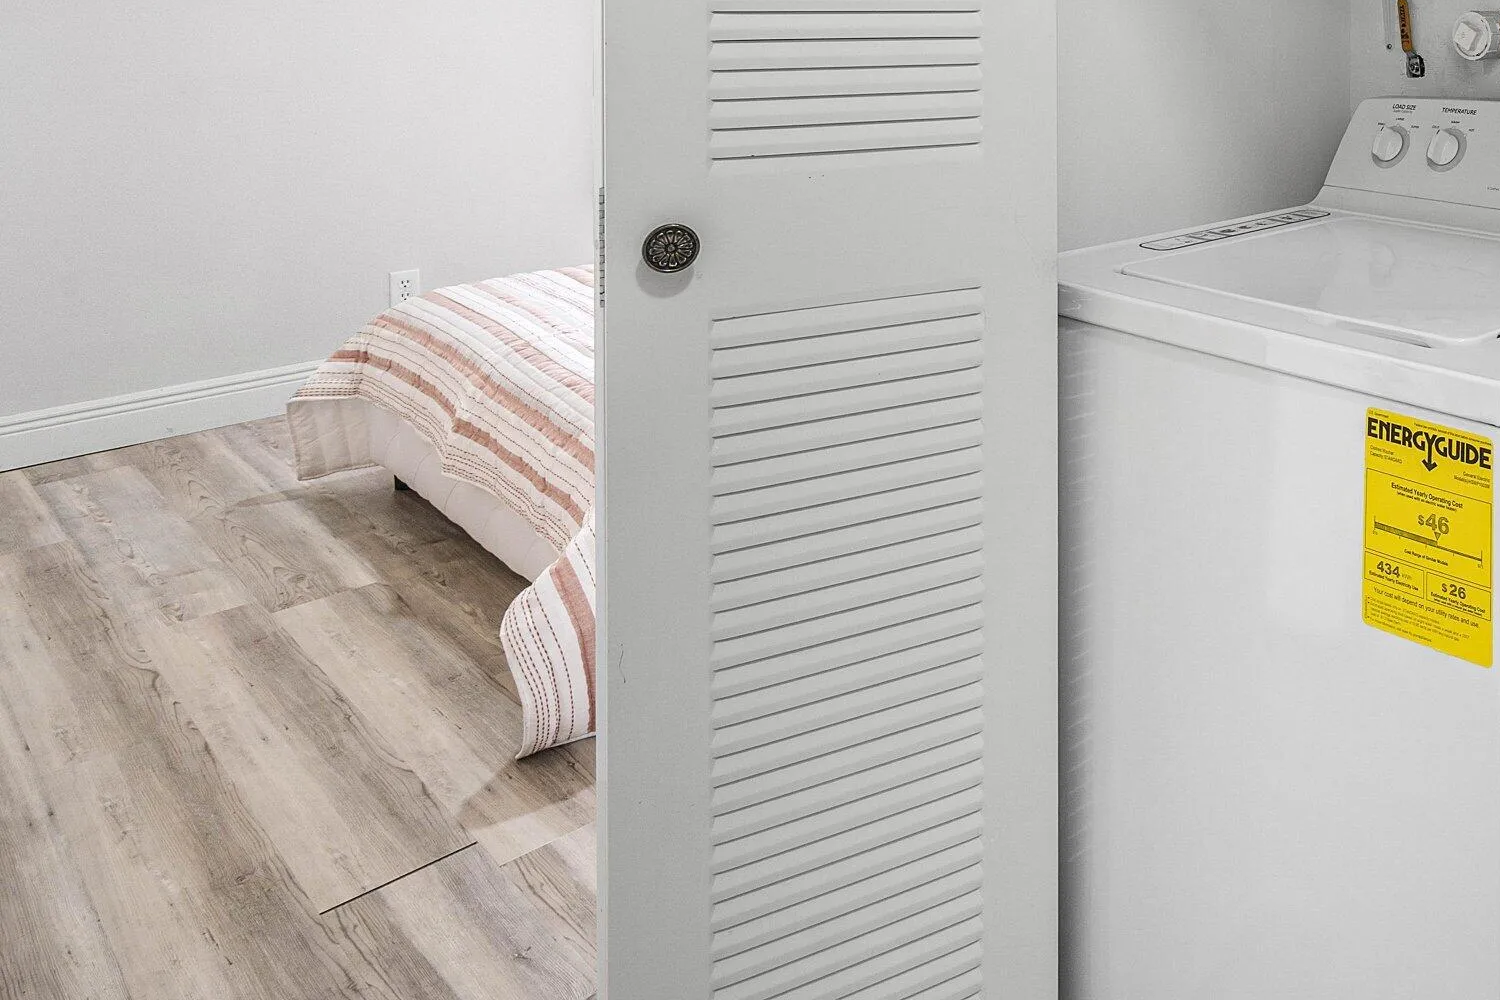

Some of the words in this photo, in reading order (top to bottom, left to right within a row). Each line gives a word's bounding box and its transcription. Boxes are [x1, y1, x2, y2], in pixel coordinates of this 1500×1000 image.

[1442, 107, 1478, 115] TEMPERATURE
[1368, 416, 1492, 470] ENERGYGUIDE
[1392, 482, 1413, 492] Estimated
[1414, 489, 1428, 499] Yearly
[1428, 494, 1451, 506] Operating
[1452, 500, 1463, 508] Cost
[1418, 514, 1450, 534] $46
[1376, 560, 1400, 578] 434
[1374, 586, 1383, 594] Your
[1402, 596, 1418, 608] depend
[1424, 606, 1434, 614] your
[1436, 608, 1448, 618] utility
[1448, 613, 1460, 621] rates
